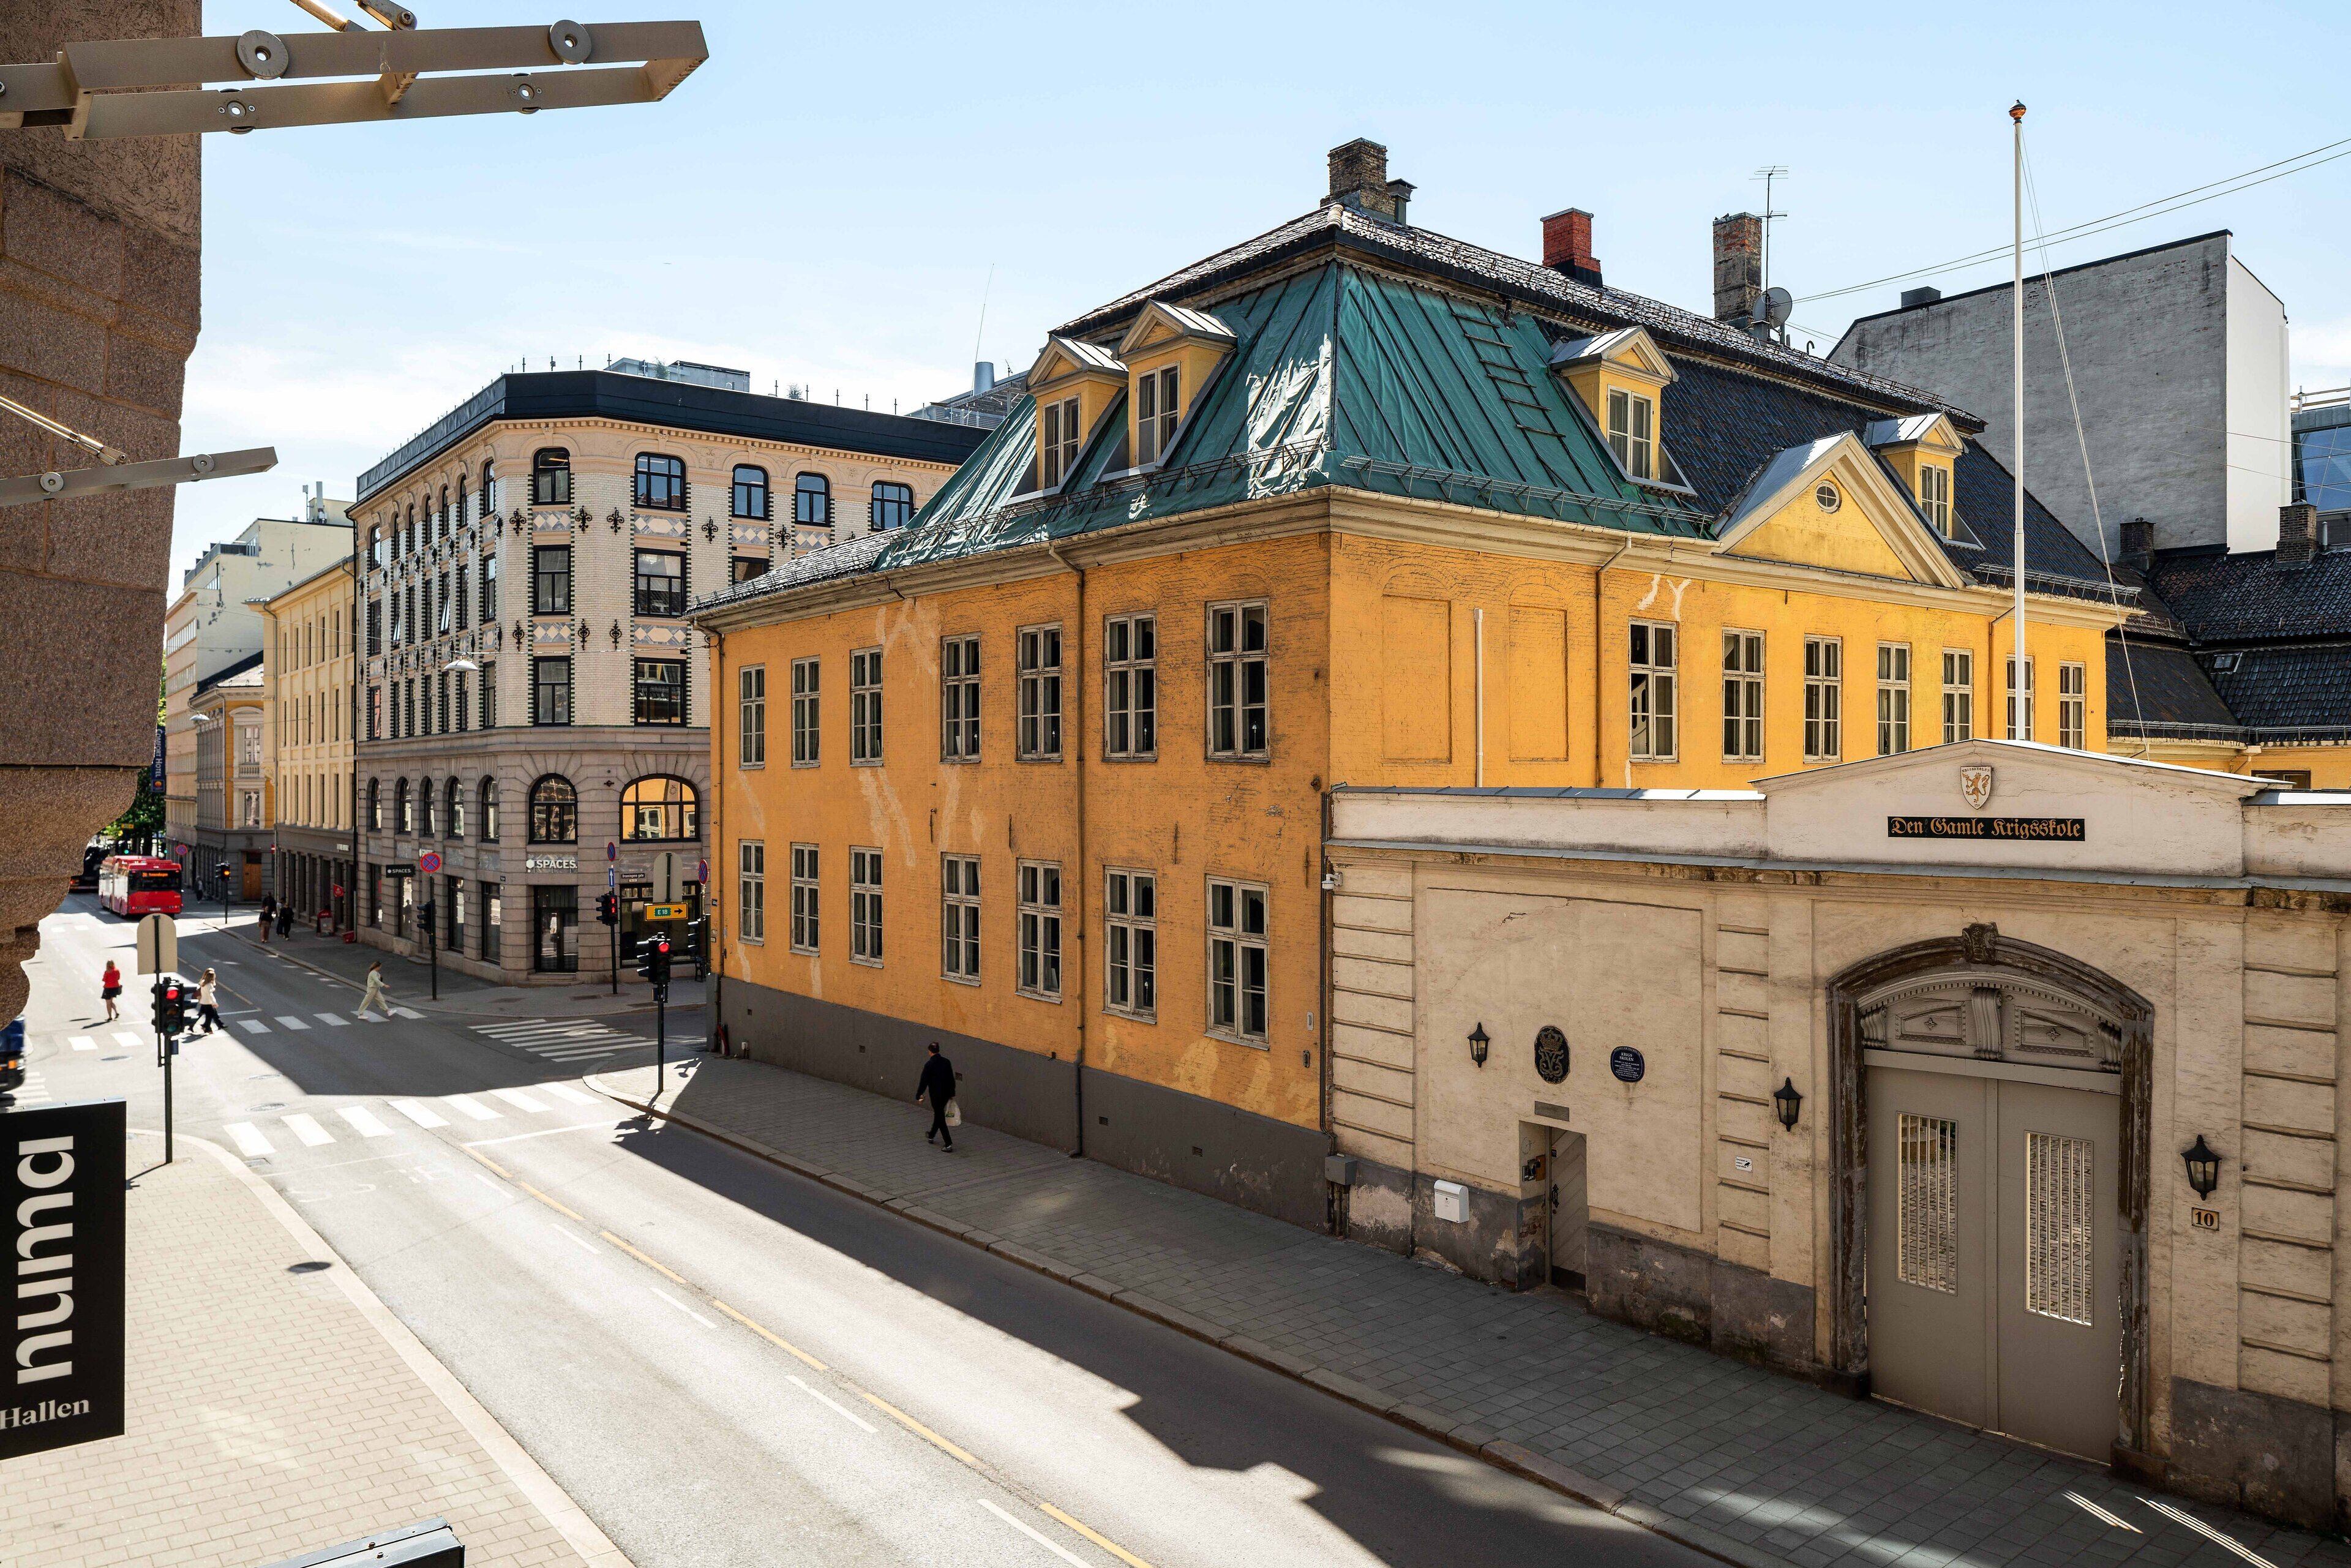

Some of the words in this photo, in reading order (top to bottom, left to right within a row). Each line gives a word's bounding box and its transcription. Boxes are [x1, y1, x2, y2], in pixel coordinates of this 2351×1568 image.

[1891, 817, 1924, 835] Den
[1930, 818, 1985, 835] Gamle
[1991, 818, 2081, 839] Krigsskole
[2195, 1211, 2214, 1227] 10
[16, 1136, 75, 1384] numa
[0, 1400, 91, 1430] Hallen
